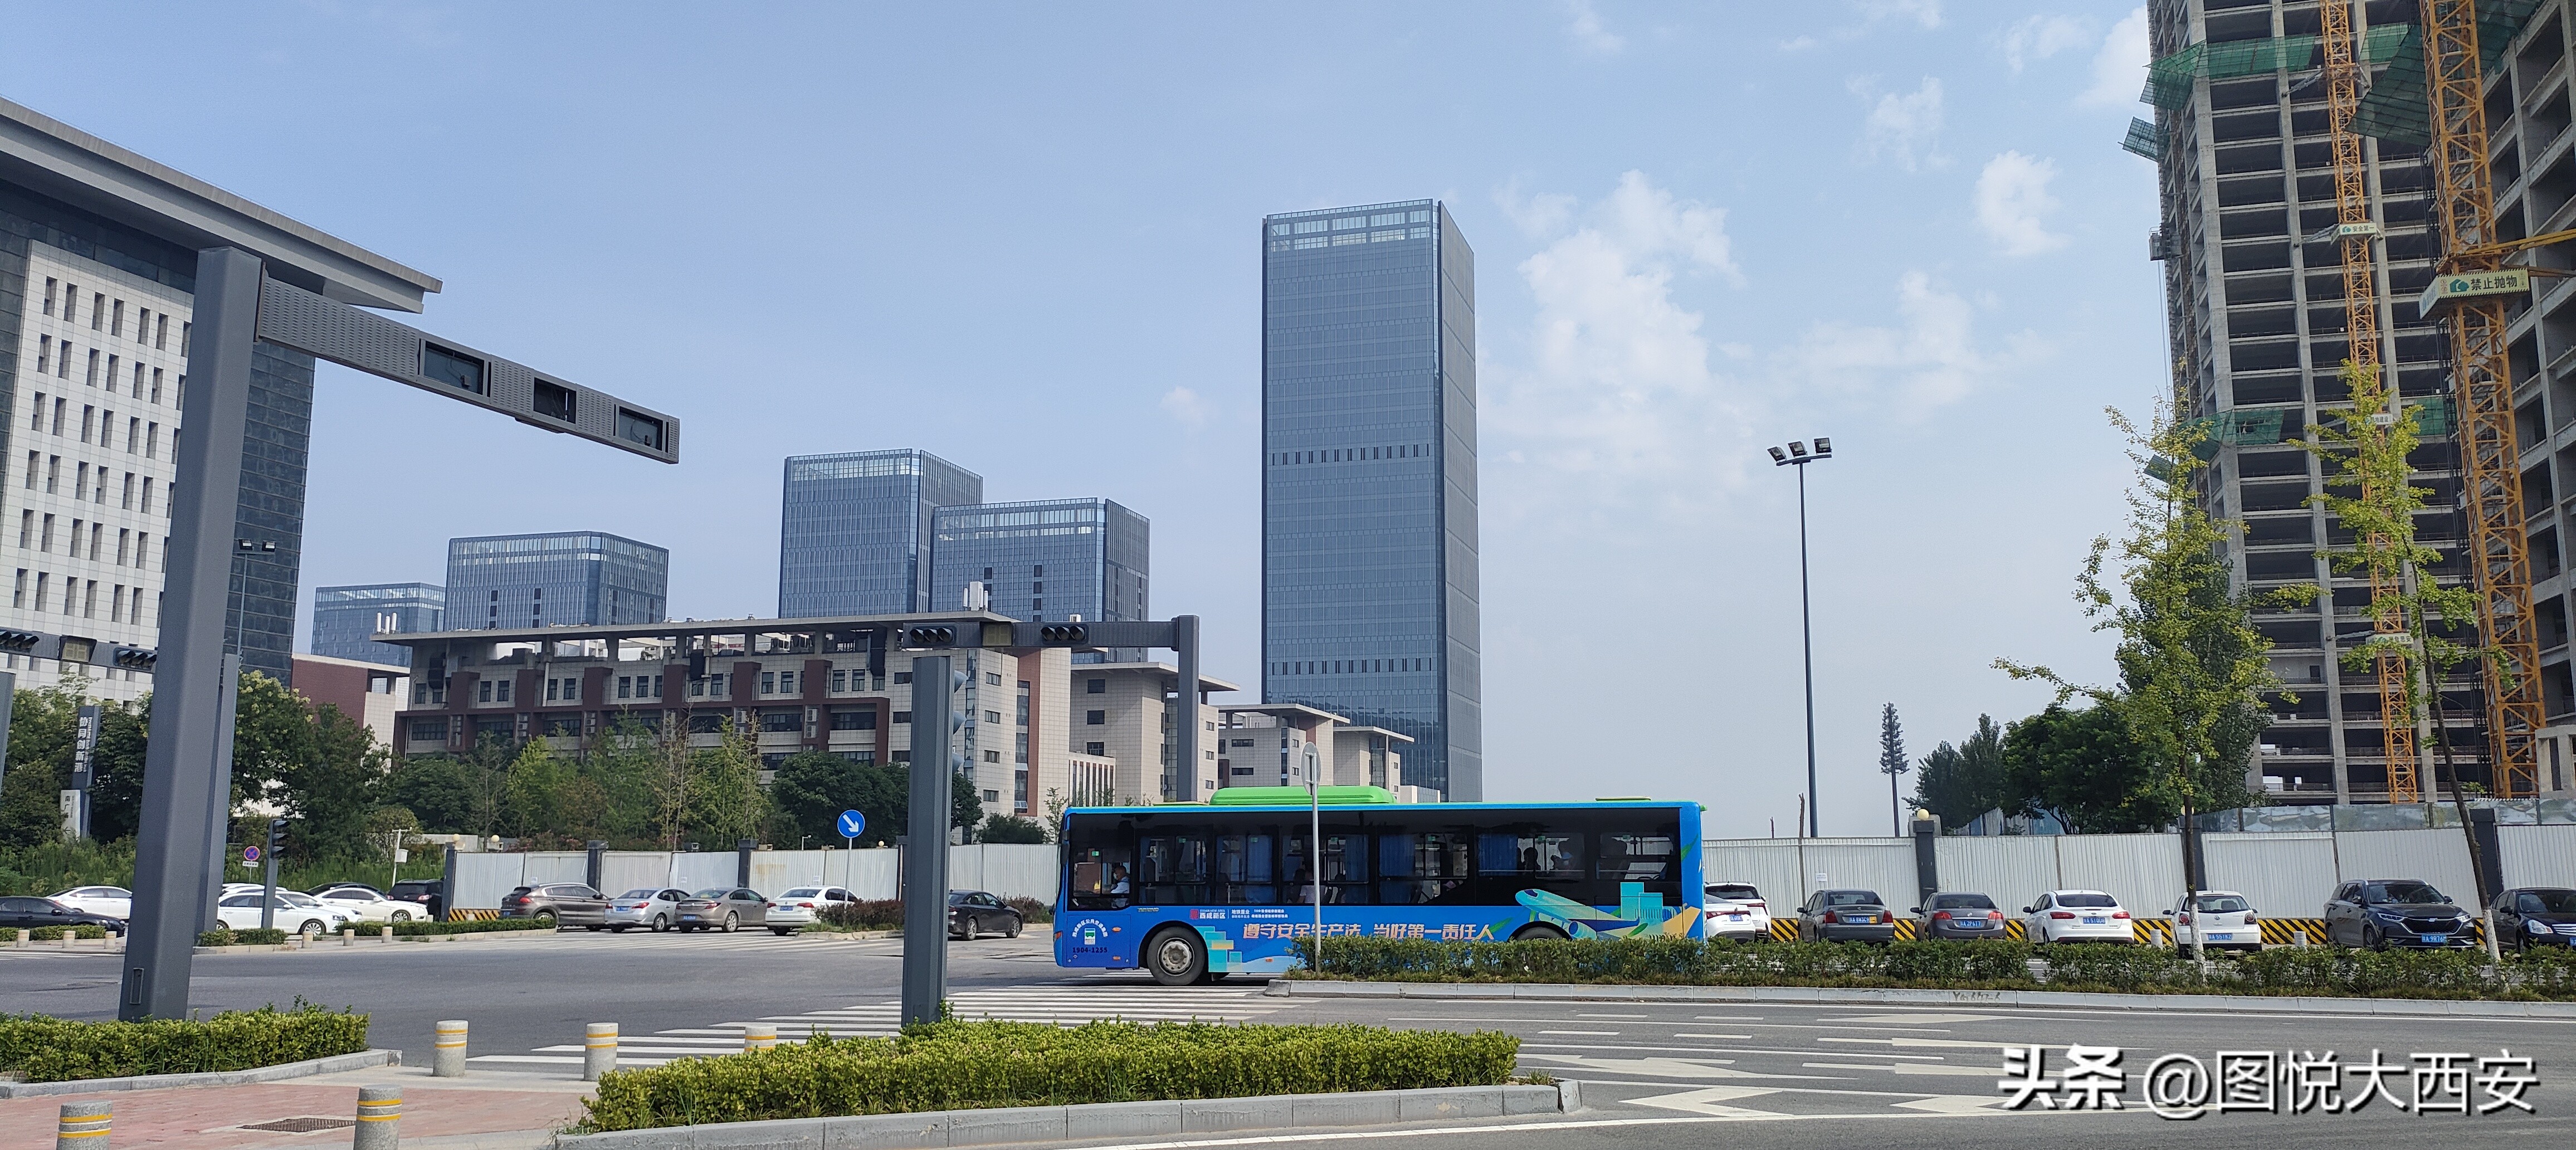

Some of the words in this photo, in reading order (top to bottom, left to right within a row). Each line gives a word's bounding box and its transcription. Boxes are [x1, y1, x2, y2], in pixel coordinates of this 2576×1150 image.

[2470, 276, 2518, 291] 禁止抛物
[74, 717, 88, 772] 协同创新港
[1243, 923, 1362, 939] 遵守安全生产法
[1373, 923, 1495, 939] 当好第一责任人
